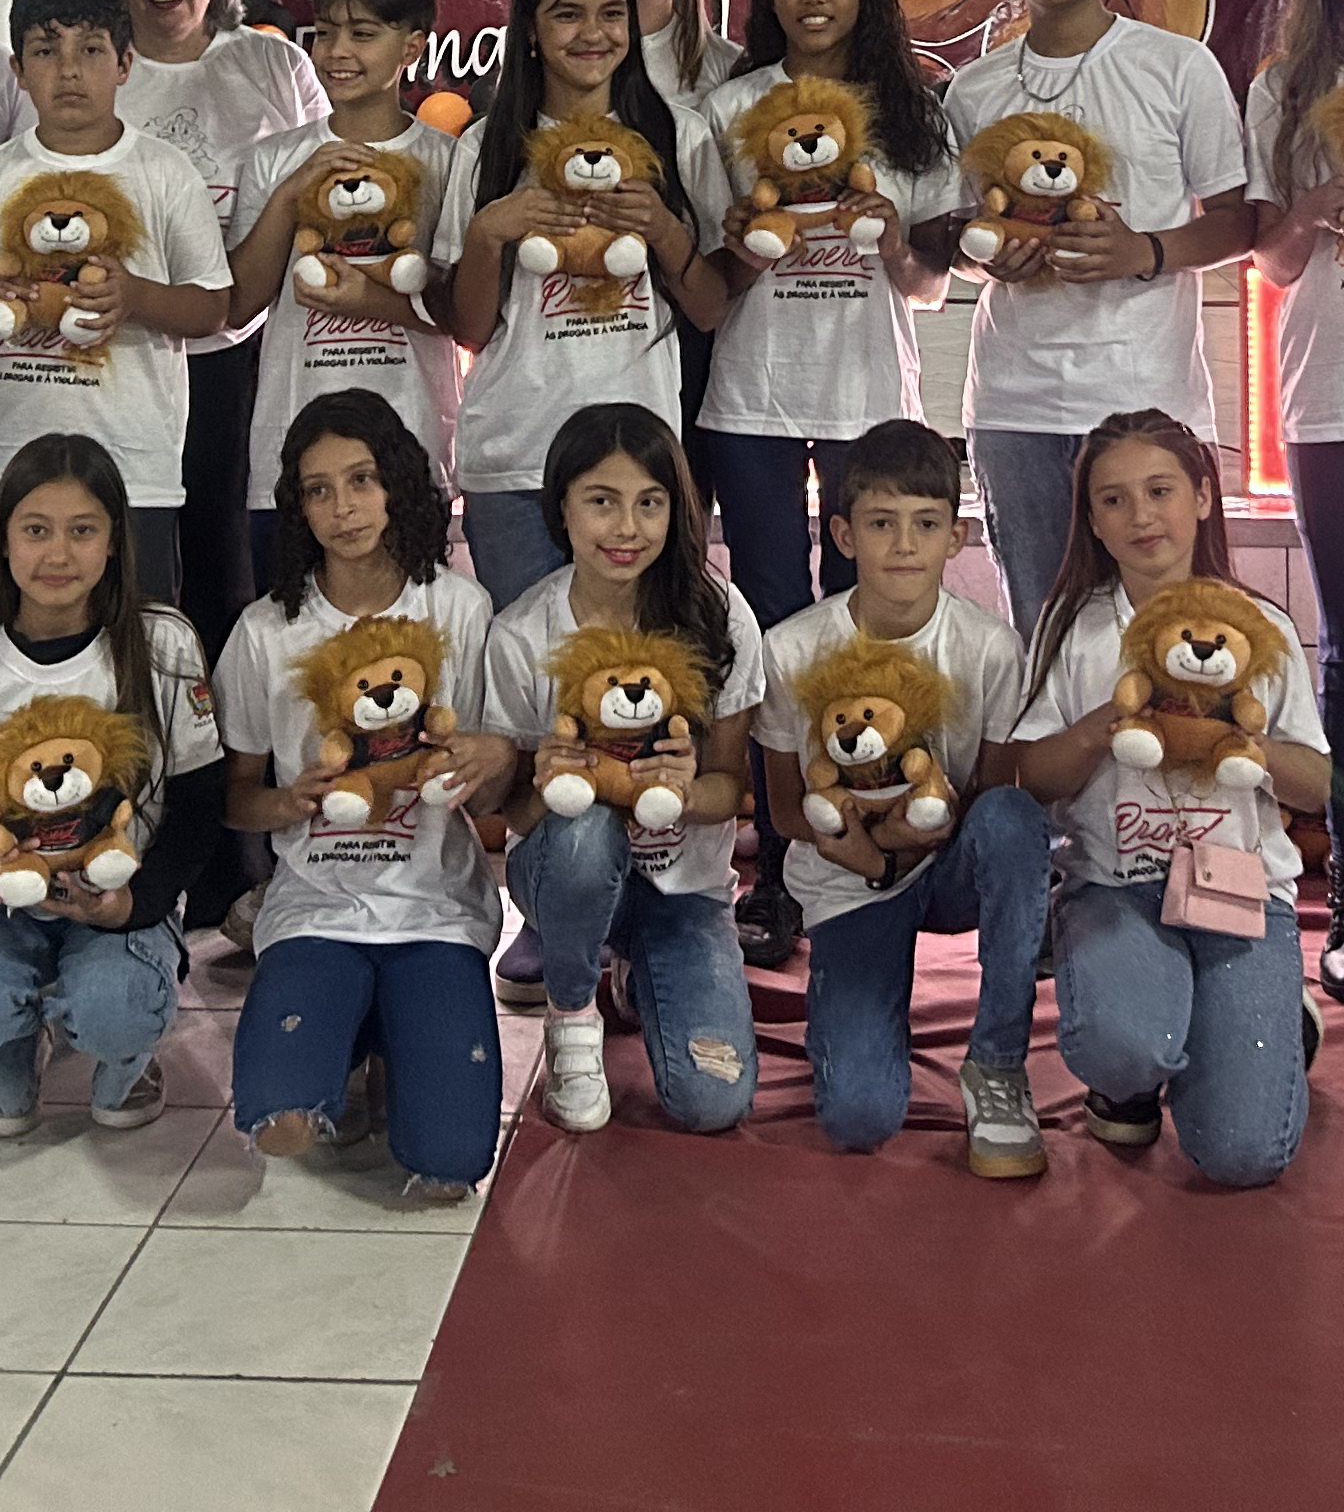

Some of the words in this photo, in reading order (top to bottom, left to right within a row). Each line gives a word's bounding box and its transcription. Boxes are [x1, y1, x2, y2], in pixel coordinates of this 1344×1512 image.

[796, 280, 817, 288] PARA
[786, 290, 819, 299] DROGAS
[566, 318, 588, 327] PARA
[545, 330, 556, 341] ÀS
[558, 327, 591, 340] DROGAS
[593, 327, 599, 335] E
[601, 324, 608, 335] À
[322, 347, 345, 356] PARA
[12, 361, 33, 371] PARA
[313, 358, 347, 368] DROGAS
[358, 356, 364, 366] À
[366, 355, 406, 366] VIOLÊNCIA
[4, 372, 34, 382] DROGAS
[44, 372, 51, 384] À
[334, 840, 360, 850] PARA
[307, 851, 319, 864] ÀS
[321, 852, 360, 863] DROGAS
